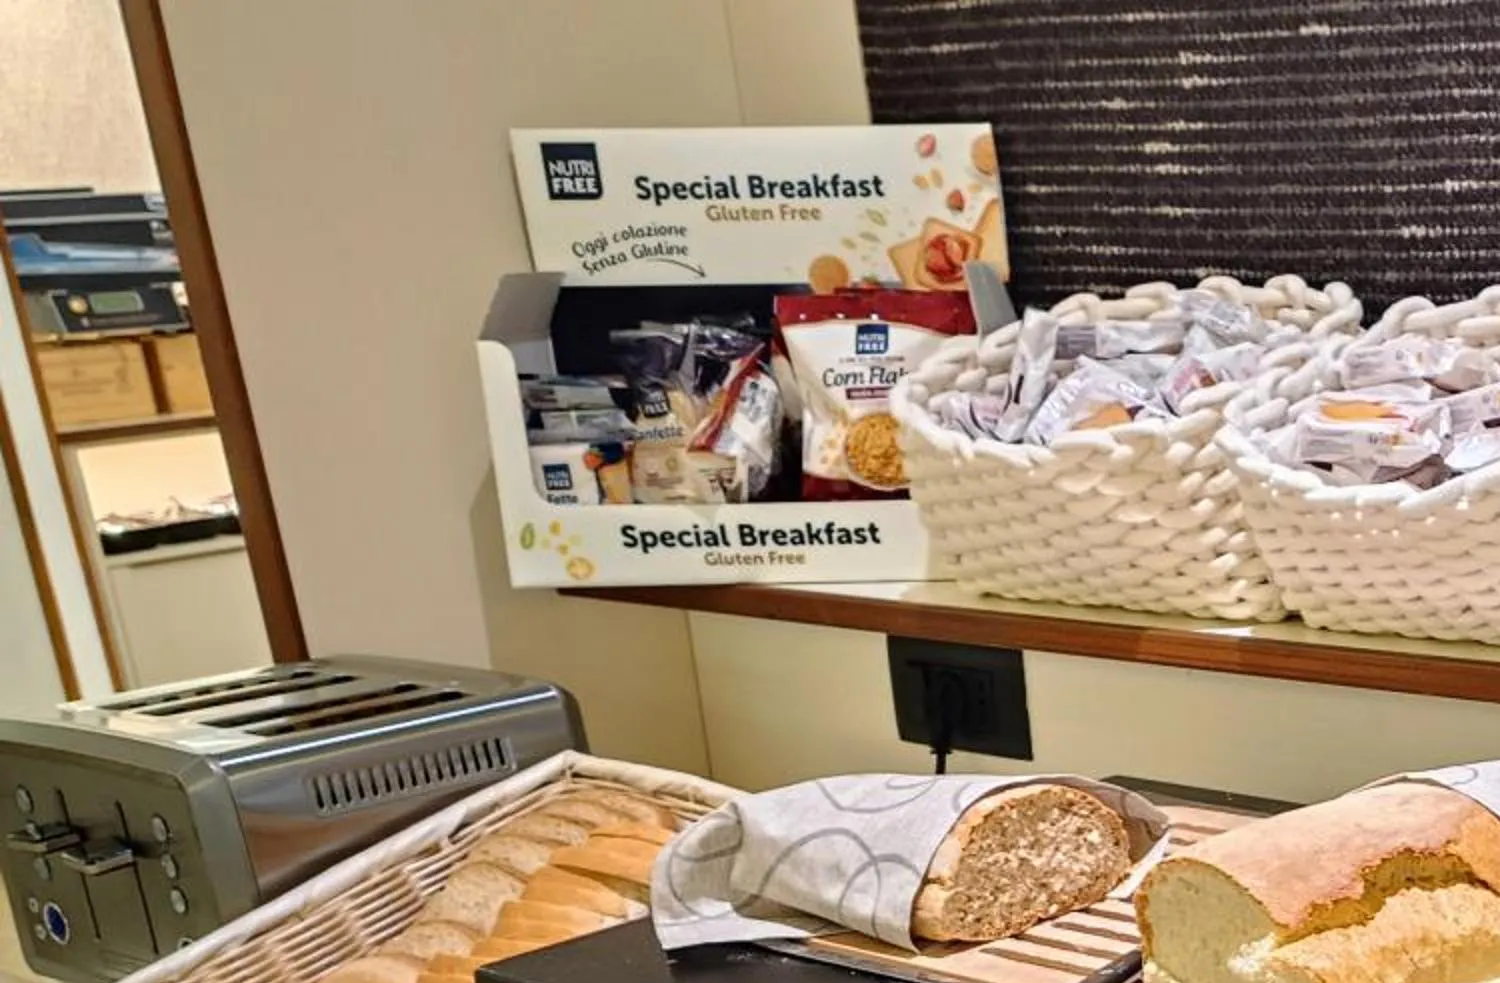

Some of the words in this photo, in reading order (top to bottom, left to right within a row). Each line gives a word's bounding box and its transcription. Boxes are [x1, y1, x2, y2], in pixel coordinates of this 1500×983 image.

[549, 159, 596, 176] NUTRI
[551, 177, 599, 193] FREE
[634, 175, 741, 206] Special
[747, 173, 885, 200] Breakfast
[705, 204, 774, 222] Gluten
[778, 203, 822, 221] Free
[571, 232, 609, 258] Oggi
[612, 224, 688, 244] colazione
[582, 253, 628, 276] Senza
[631, 241, 689, 260] Glutine
[822, 367, 865, 388] Corn
[620, 524, 731, 554] Special
[738, 522, 881, 547] Breakfast
[704, 552, 764, 566] Gluten
[767, 551, 806, 565] Free
